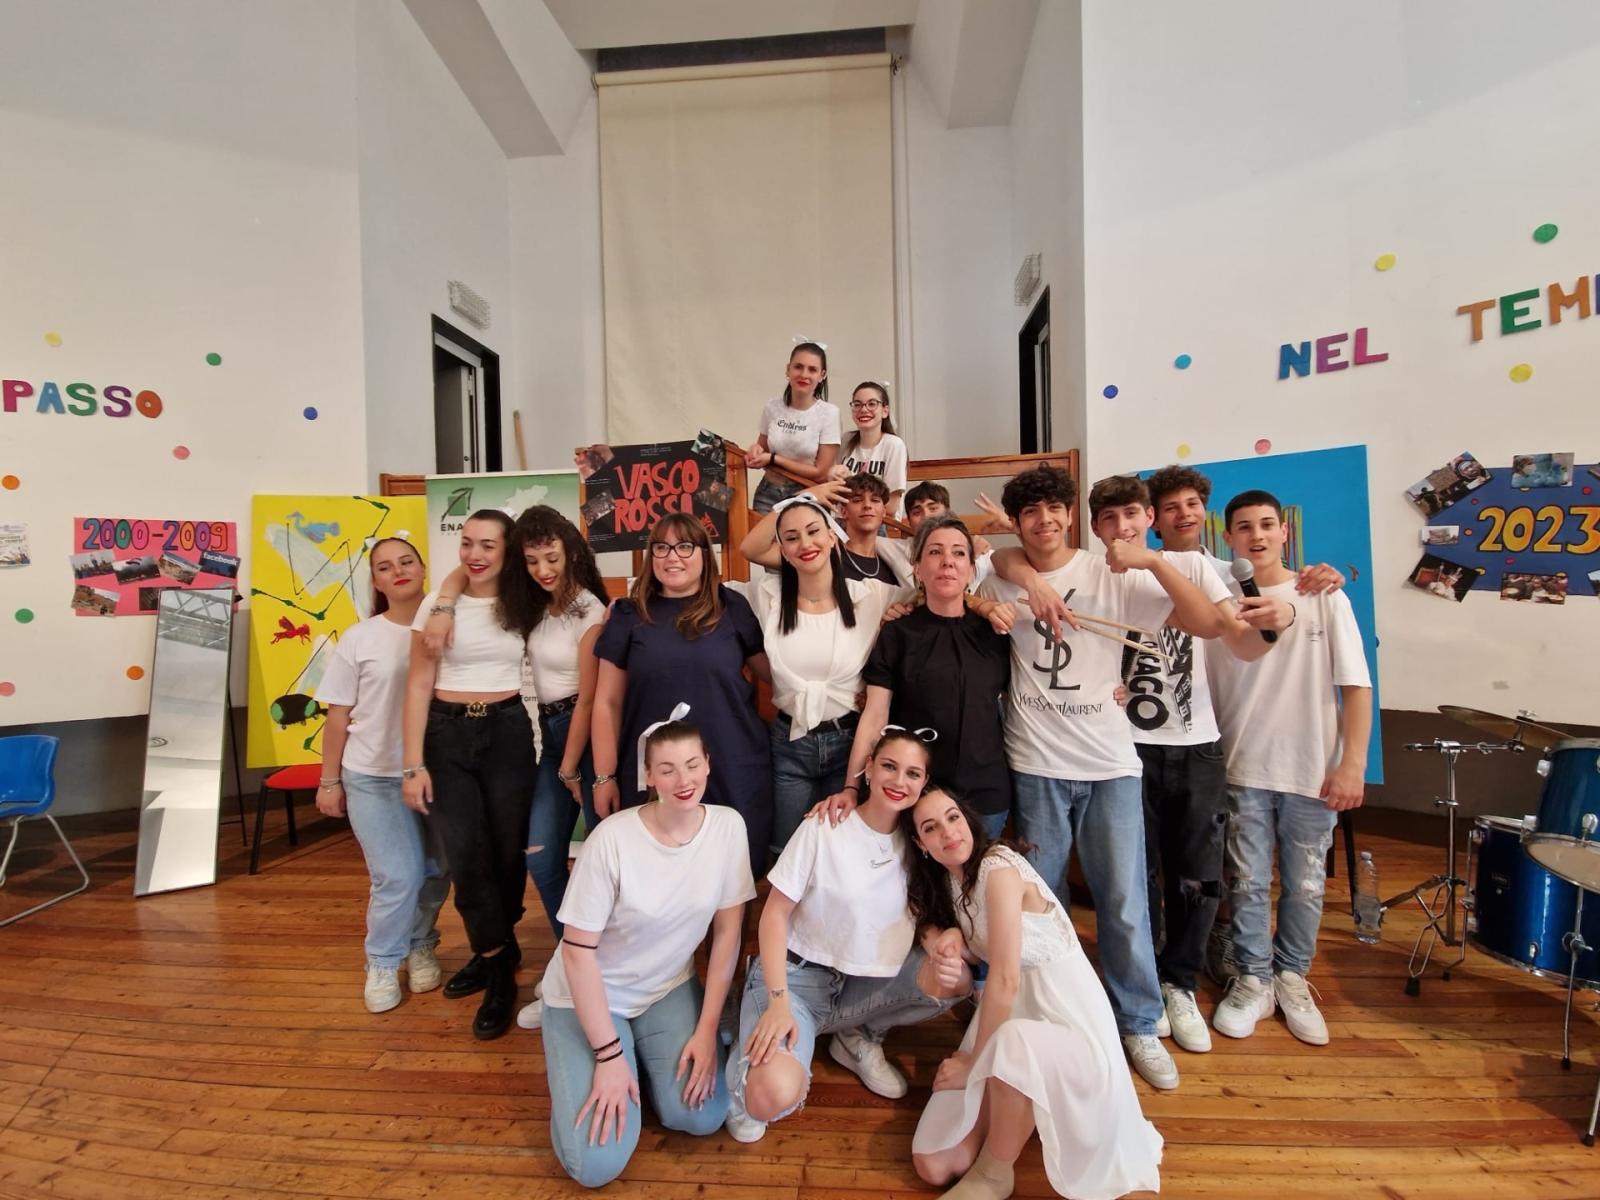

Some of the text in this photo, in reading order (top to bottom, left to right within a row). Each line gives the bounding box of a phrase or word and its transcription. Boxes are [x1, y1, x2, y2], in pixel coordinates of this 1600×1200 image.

[1278, 273, 1600, 380] NEL TEM
[2, 379, 163, 419] PASSO
[614, 459, 700, 500] VASCO
[614, 493, 693, 534] ROSSI
[1477, 504, 1600, 555] 2023
[82, 517, 228, 552] 2000-2009
[203, 551, 237, 566] facebook
